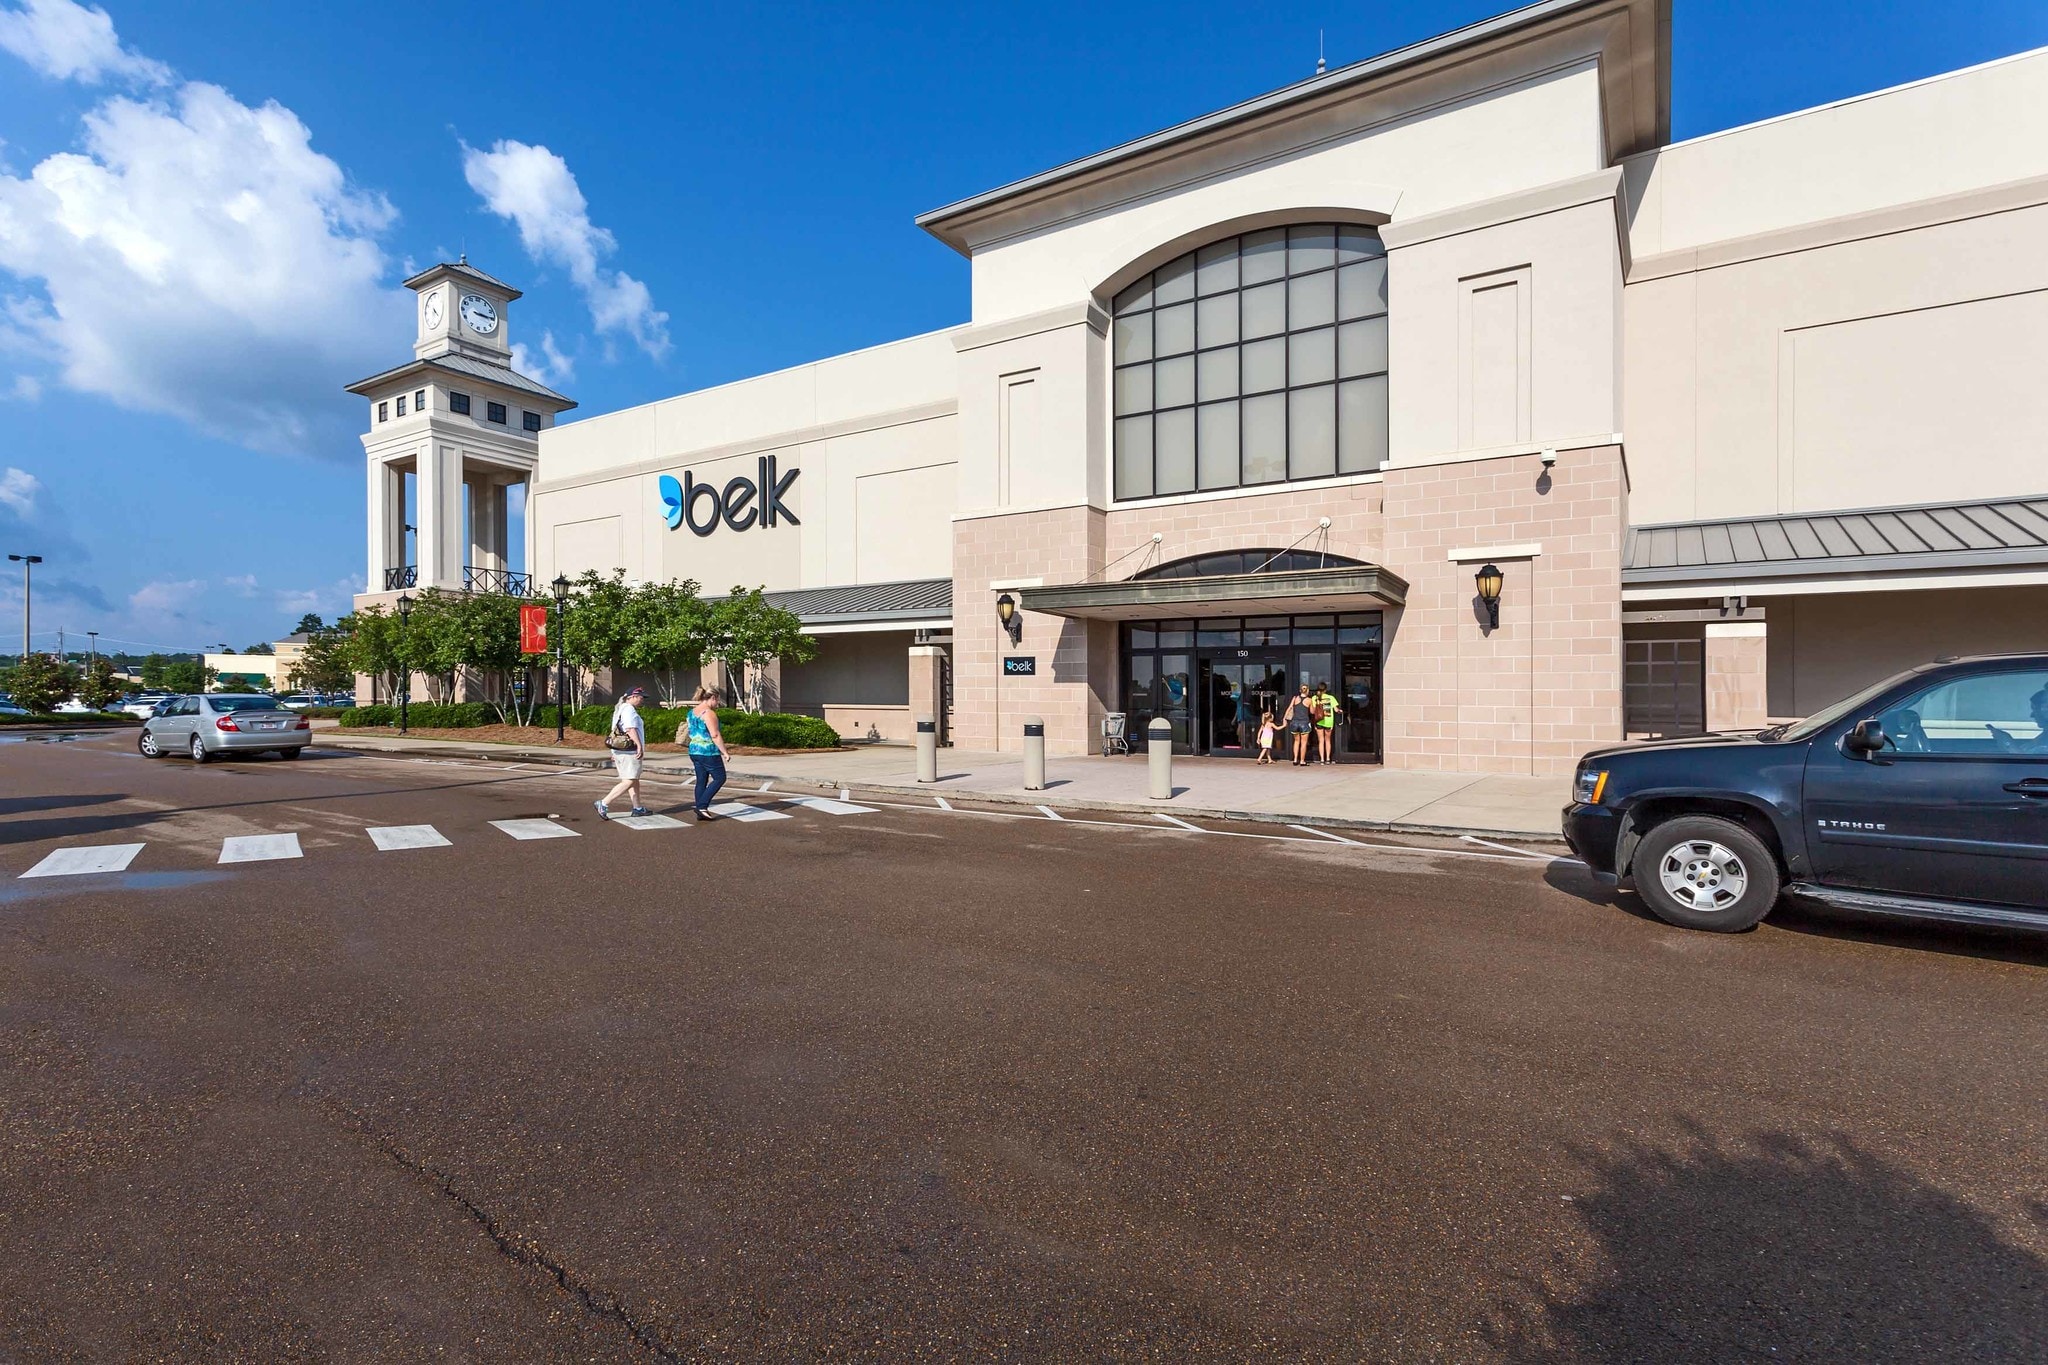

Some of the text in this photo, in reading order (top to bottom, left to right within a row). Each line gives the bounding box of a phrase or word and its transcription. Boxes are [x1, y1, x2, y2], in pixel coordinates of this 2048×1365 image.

[685, 455, 801, 537] belk
[1011, 660, 1032, 671] belk
[1830, 820, 1886, 831] TAHOE
